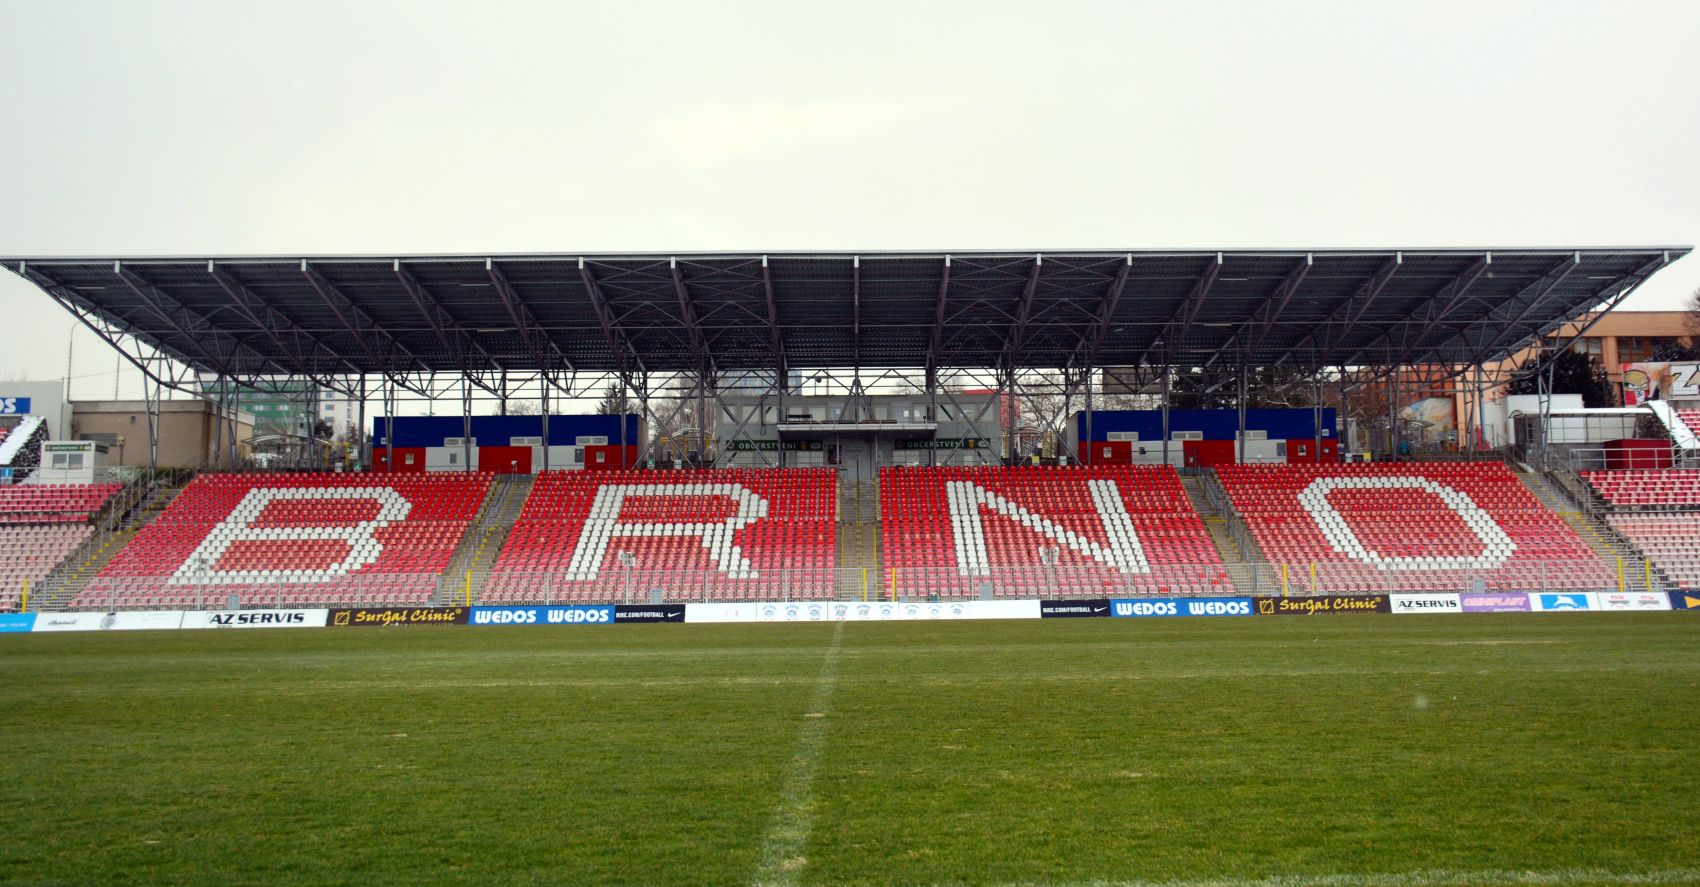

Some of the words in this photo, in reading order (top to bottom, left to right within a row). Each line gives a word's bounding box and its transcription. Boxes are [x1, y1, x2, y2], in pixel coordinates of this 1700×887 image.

[168, 479, 1518, 586] BRNO
[1116, 602, 1177, 615] WEDOS
[1188, 601, 1250, 615] WEDOS
[1399, 600, 1413, 608] AZ
[1415, 600, 1457, 608] SERVIS
[210, 613, 235, 625] AZ
[237, 612, 305, 624] SERVIS
[474, 610, 536, 624] WEDOS
[547, 609, 609, 623] WEDOS
